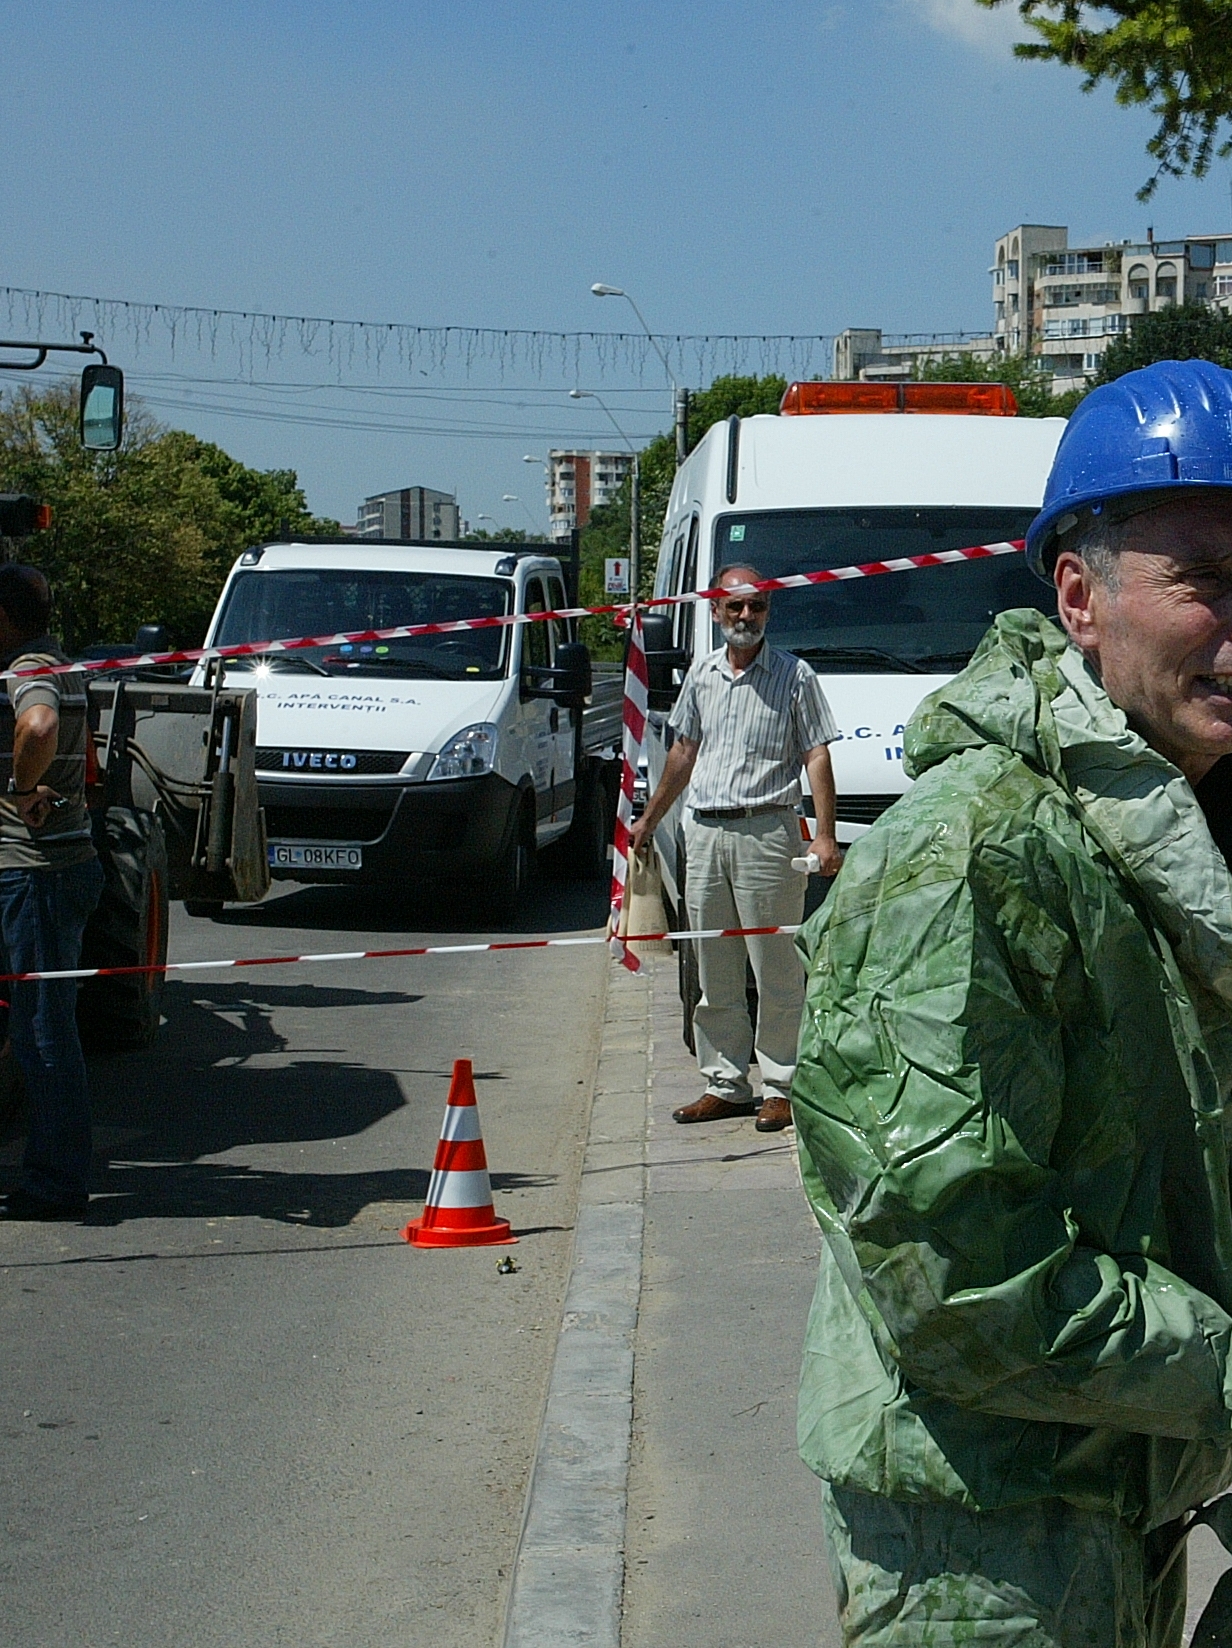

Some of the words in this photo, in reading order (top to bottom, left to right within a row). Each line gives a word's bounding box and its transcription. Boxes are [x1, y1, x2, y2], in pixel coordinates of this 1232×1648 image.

[328, 694, 384, 702] CANAL
[390, 697, 422, 706] S.A.
[282, 752, 357, 768] IVECO
[276, 848, 298, 863] GL
